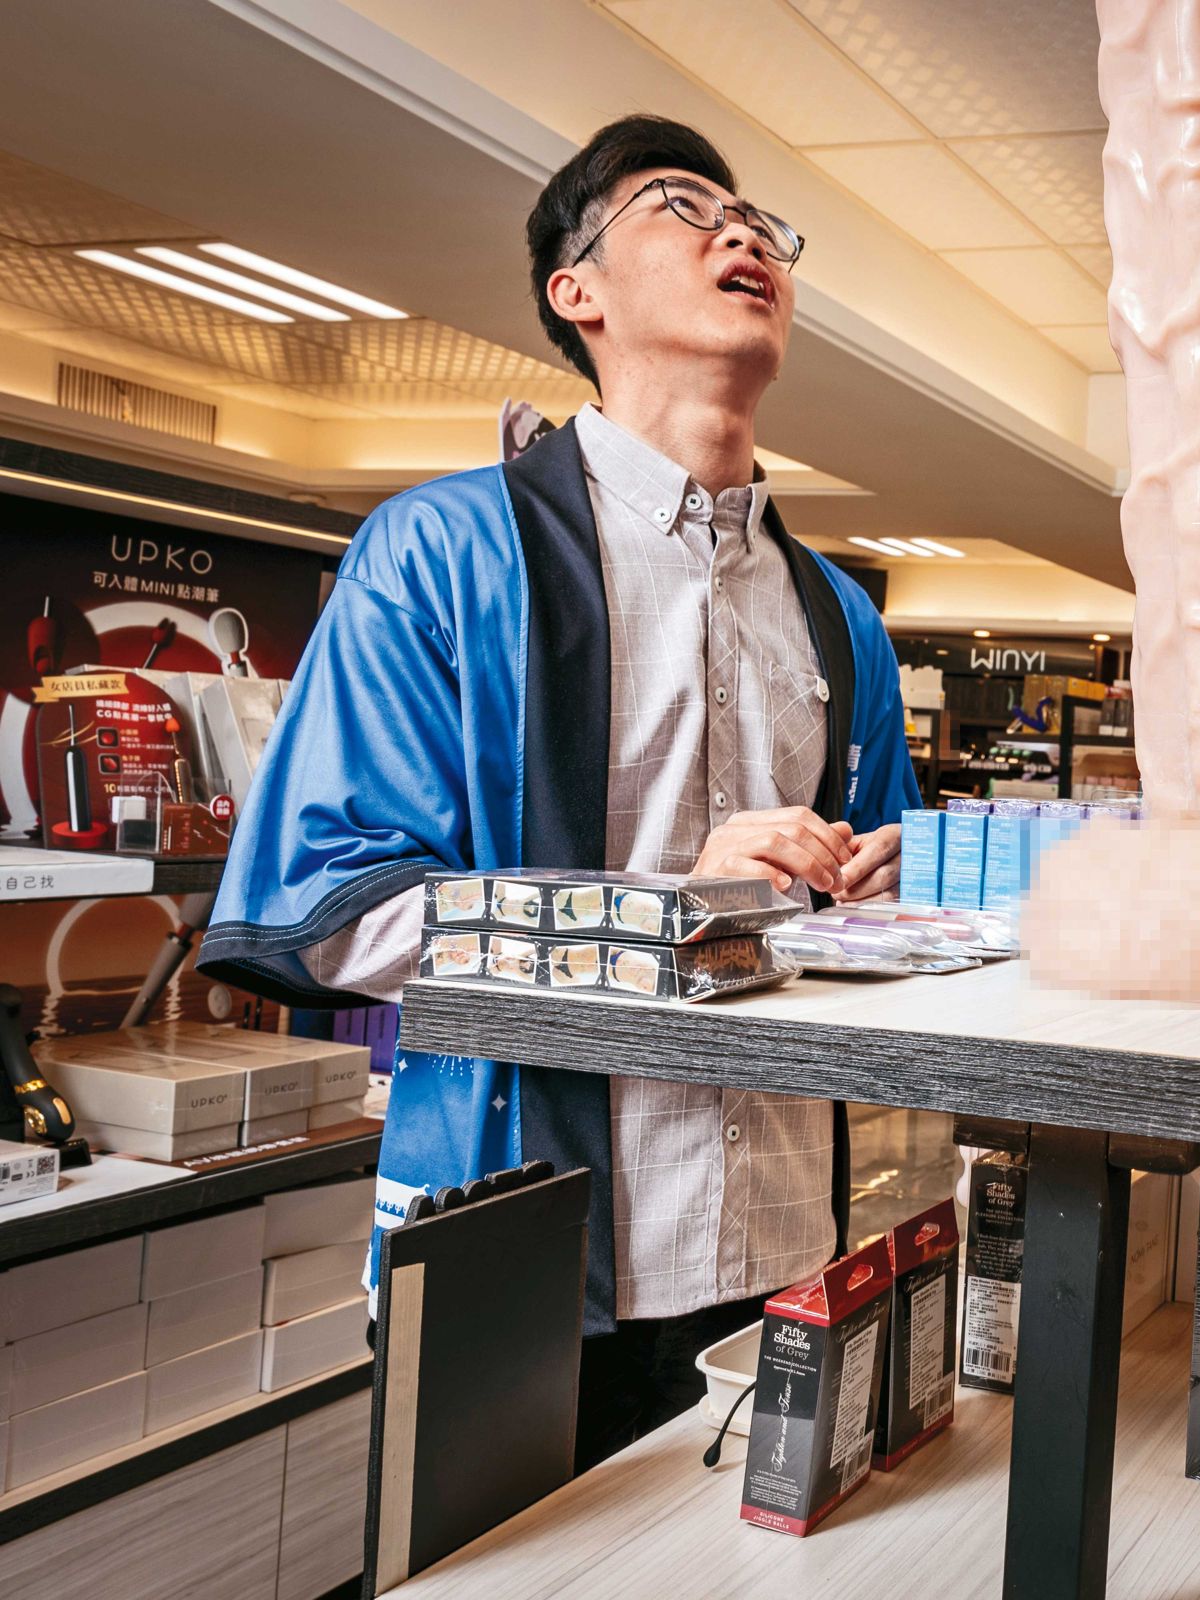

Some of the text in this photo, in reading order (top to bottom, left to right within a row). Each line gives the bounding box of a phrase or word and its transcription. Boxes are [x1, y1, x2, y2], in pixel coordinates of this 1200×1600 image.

[111, 535, 213, 575] UPKO
[970, 648, 1046, 672] WINYI
[50, 680, 122, 692] 女店員私藏款
[0, 874, 54, 890] 自己找
[781, 1324, 808, 1341] Fifty
[773, 1332, 811, 1351] Shades
[775, 1345, 810, 1361] of Grey
